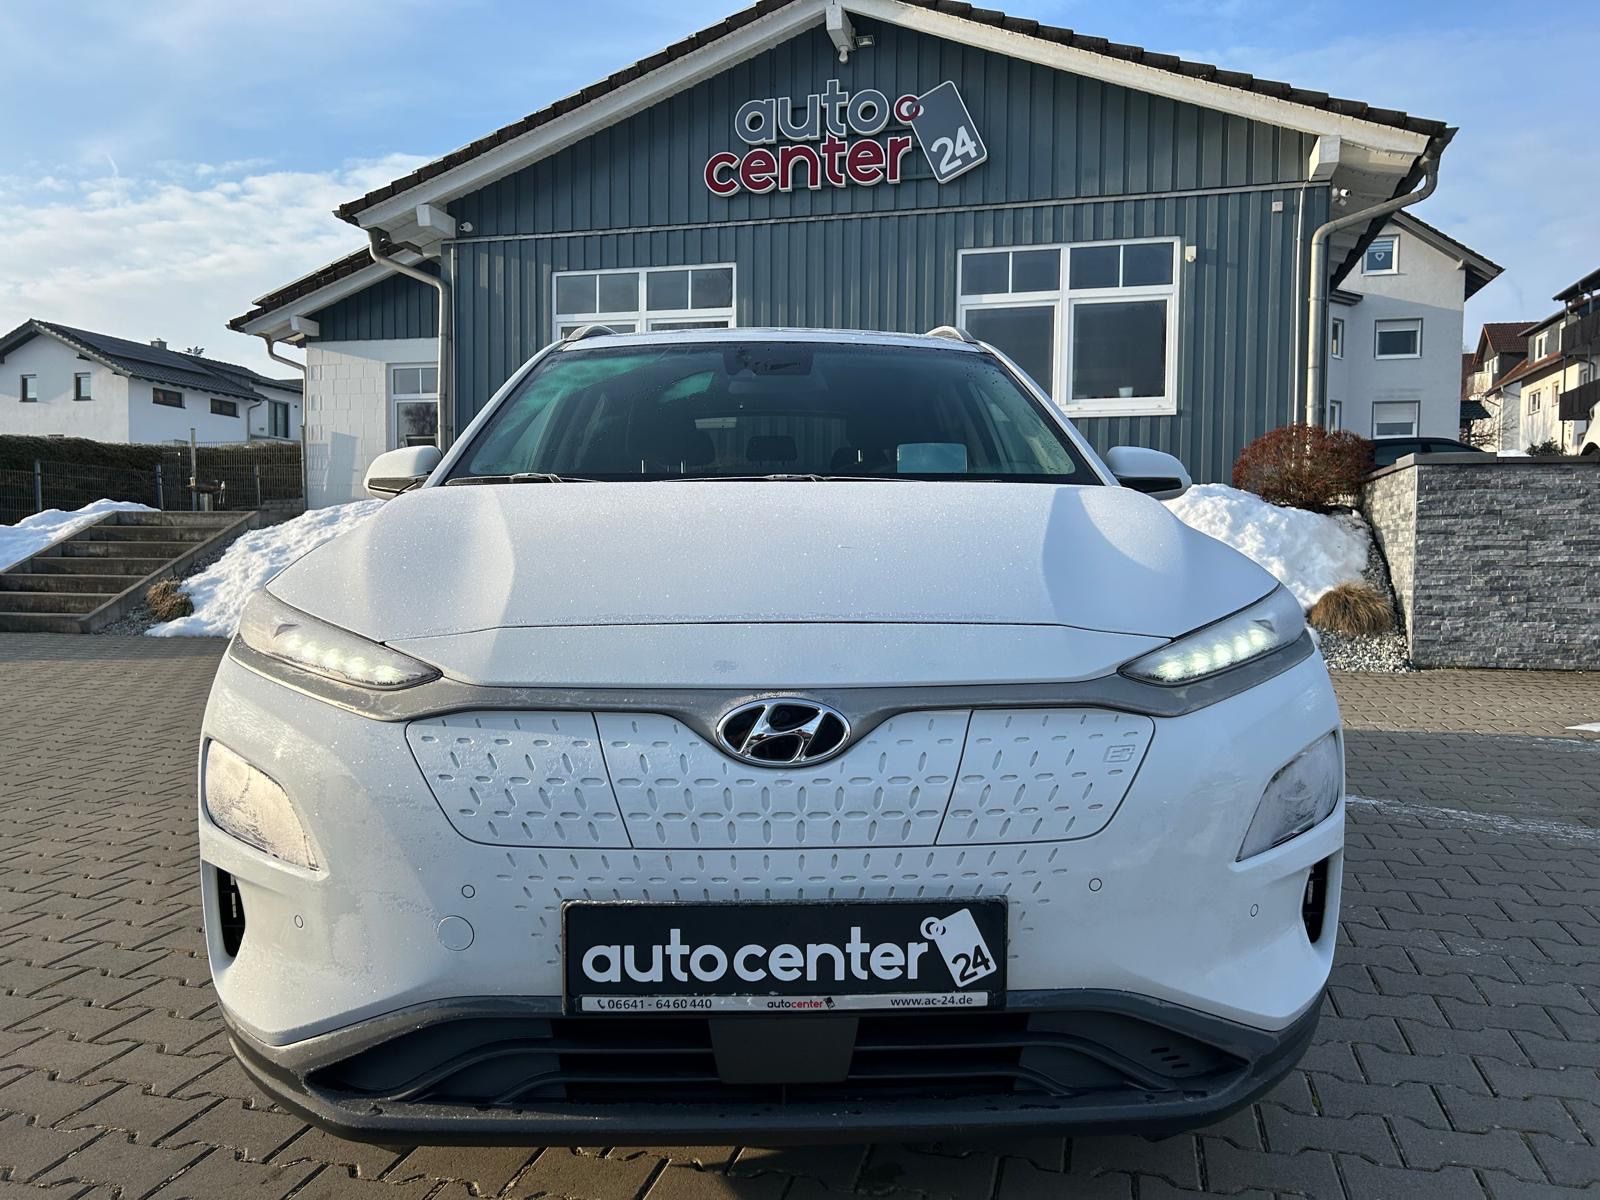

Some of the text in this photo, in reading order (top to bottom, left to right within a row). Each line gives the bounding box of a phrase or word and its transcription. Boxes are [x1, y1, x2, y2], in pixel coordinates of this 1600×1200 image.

[735, 78, 890, 145] auto
[704, 130, 912, 197] center
[930, 125, 977, 175] 24
[951, 944, 991, 982] 24
[607, 998, 644, 1010] 06641
[767, 999, 824, 1009] autocenter
[890, 994, 974, 1006] www.ac-24.de
